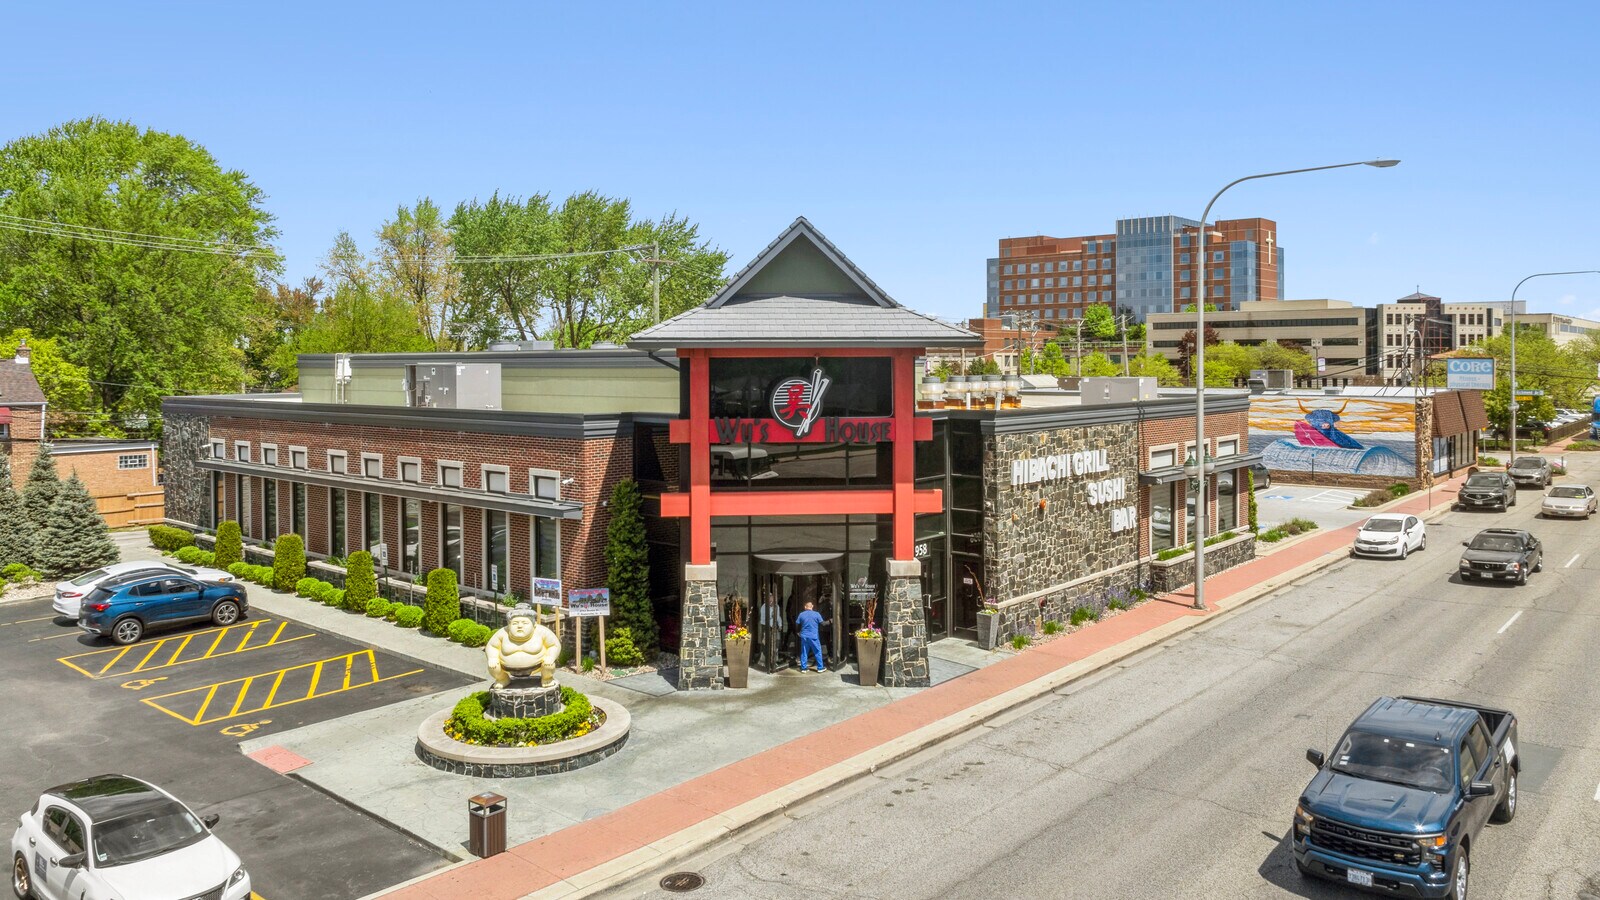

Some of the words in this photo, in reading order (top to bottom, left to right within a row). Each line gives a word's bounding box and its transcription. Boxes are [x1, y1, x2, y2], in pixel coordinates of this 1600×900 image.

[1011, 454, 1071, 486] HIBACHI
[1072, 449, 1110, 476] GRILL
[1087, 477, 1125, 506] SUSHI
[1111, 506, 1137, 533] BAR
[1316, 821, 1411, 846] CHEVROLET
